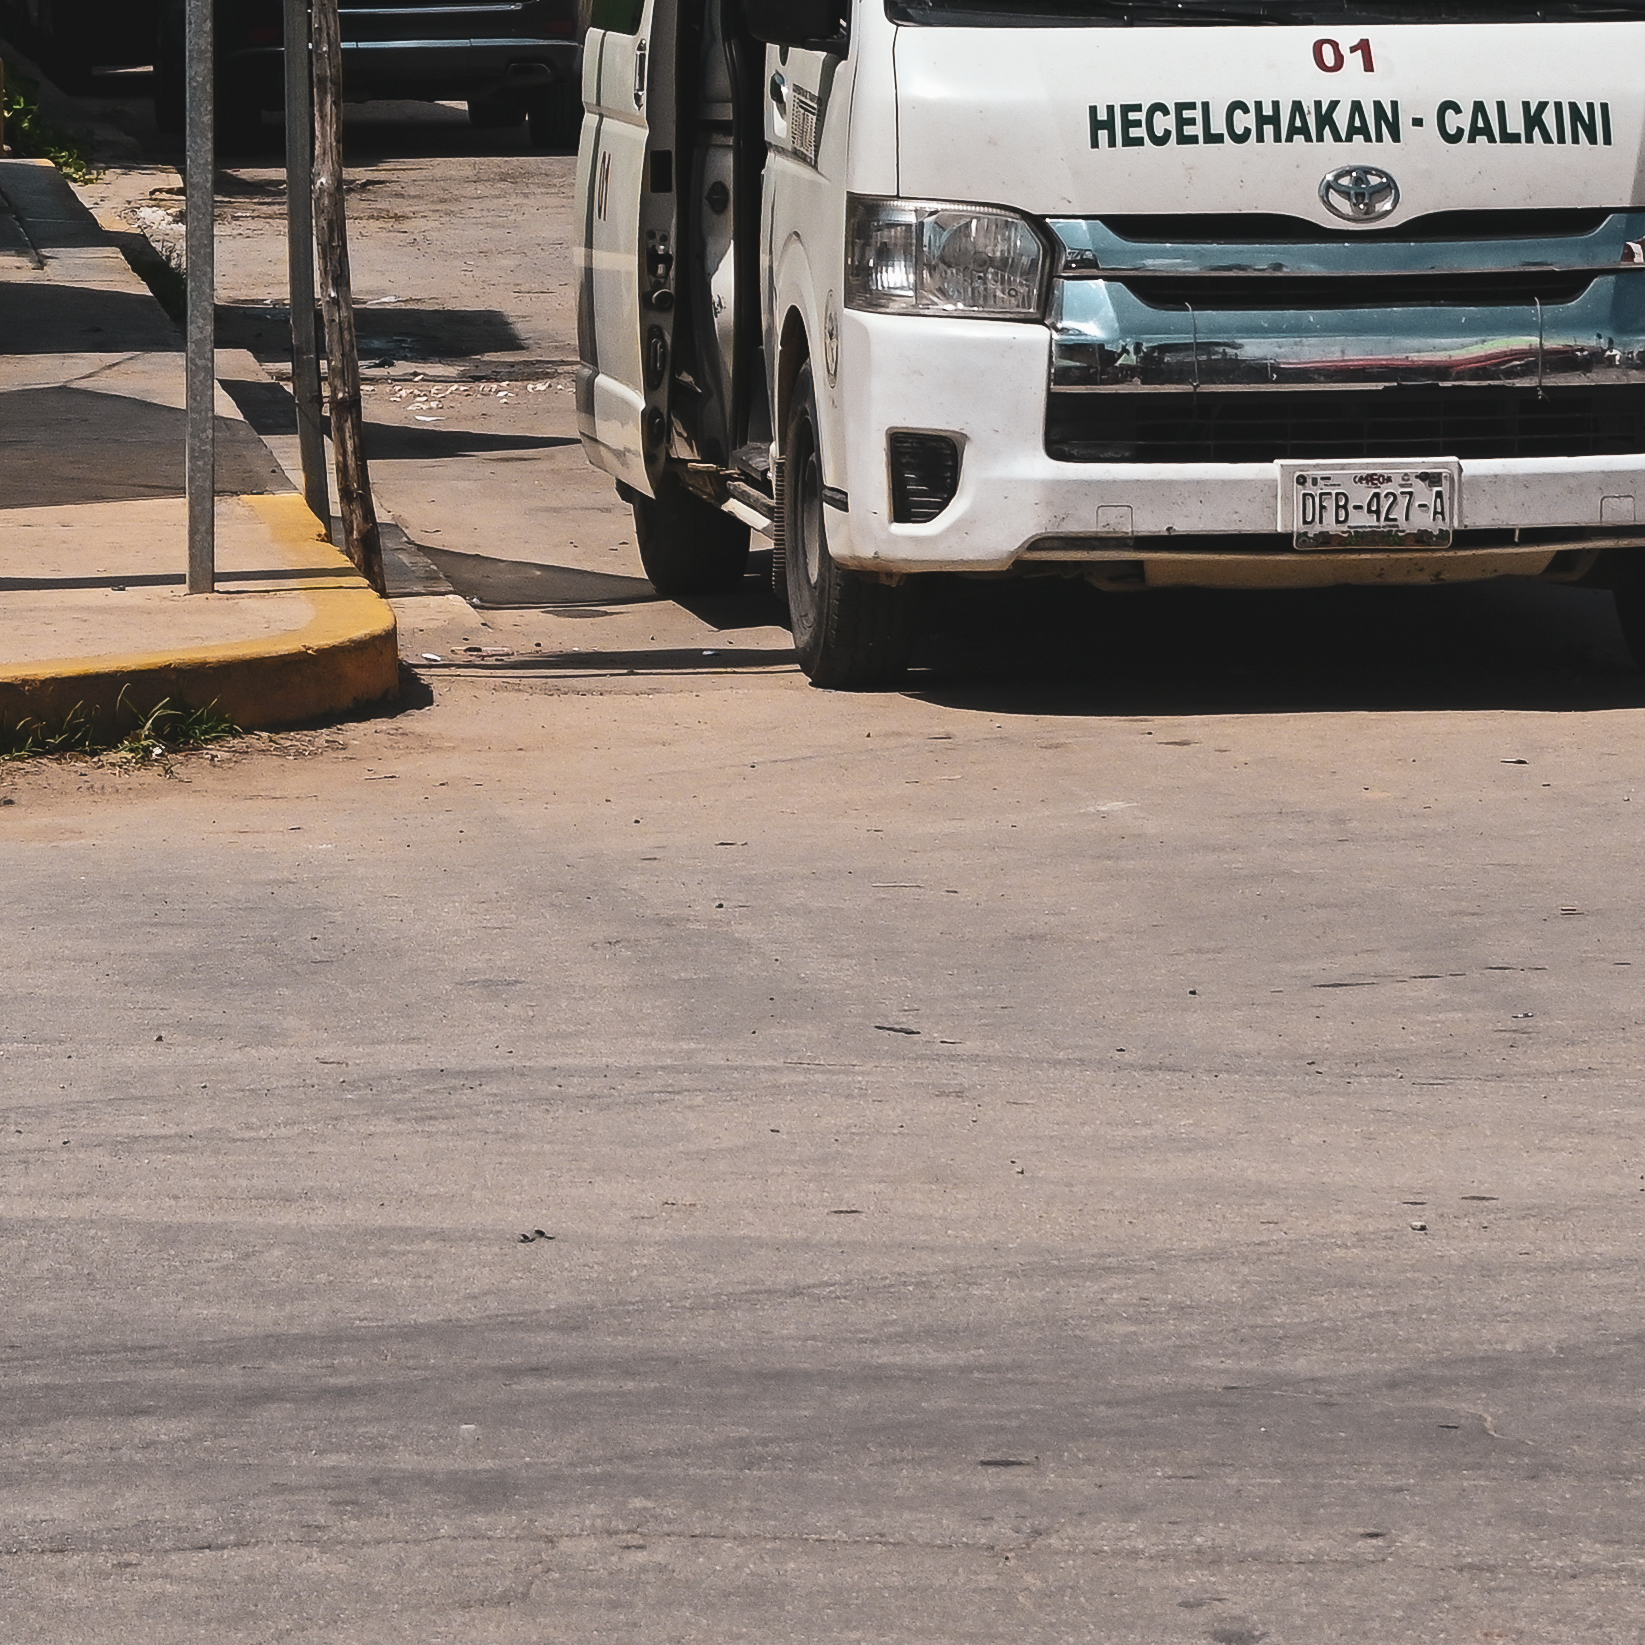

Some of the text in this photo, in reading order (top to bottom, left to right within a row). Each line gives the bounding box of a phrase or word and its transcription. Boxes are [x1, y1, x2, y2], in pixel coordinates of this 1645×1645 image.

[1311, 37, 1376, 74] 01
[1088, 99, 1401, 149] HECELCHAKAN
[1435, 99, 1614, 147] CALKINI
[1301, 489, 1446, 526] DFB-427-A
